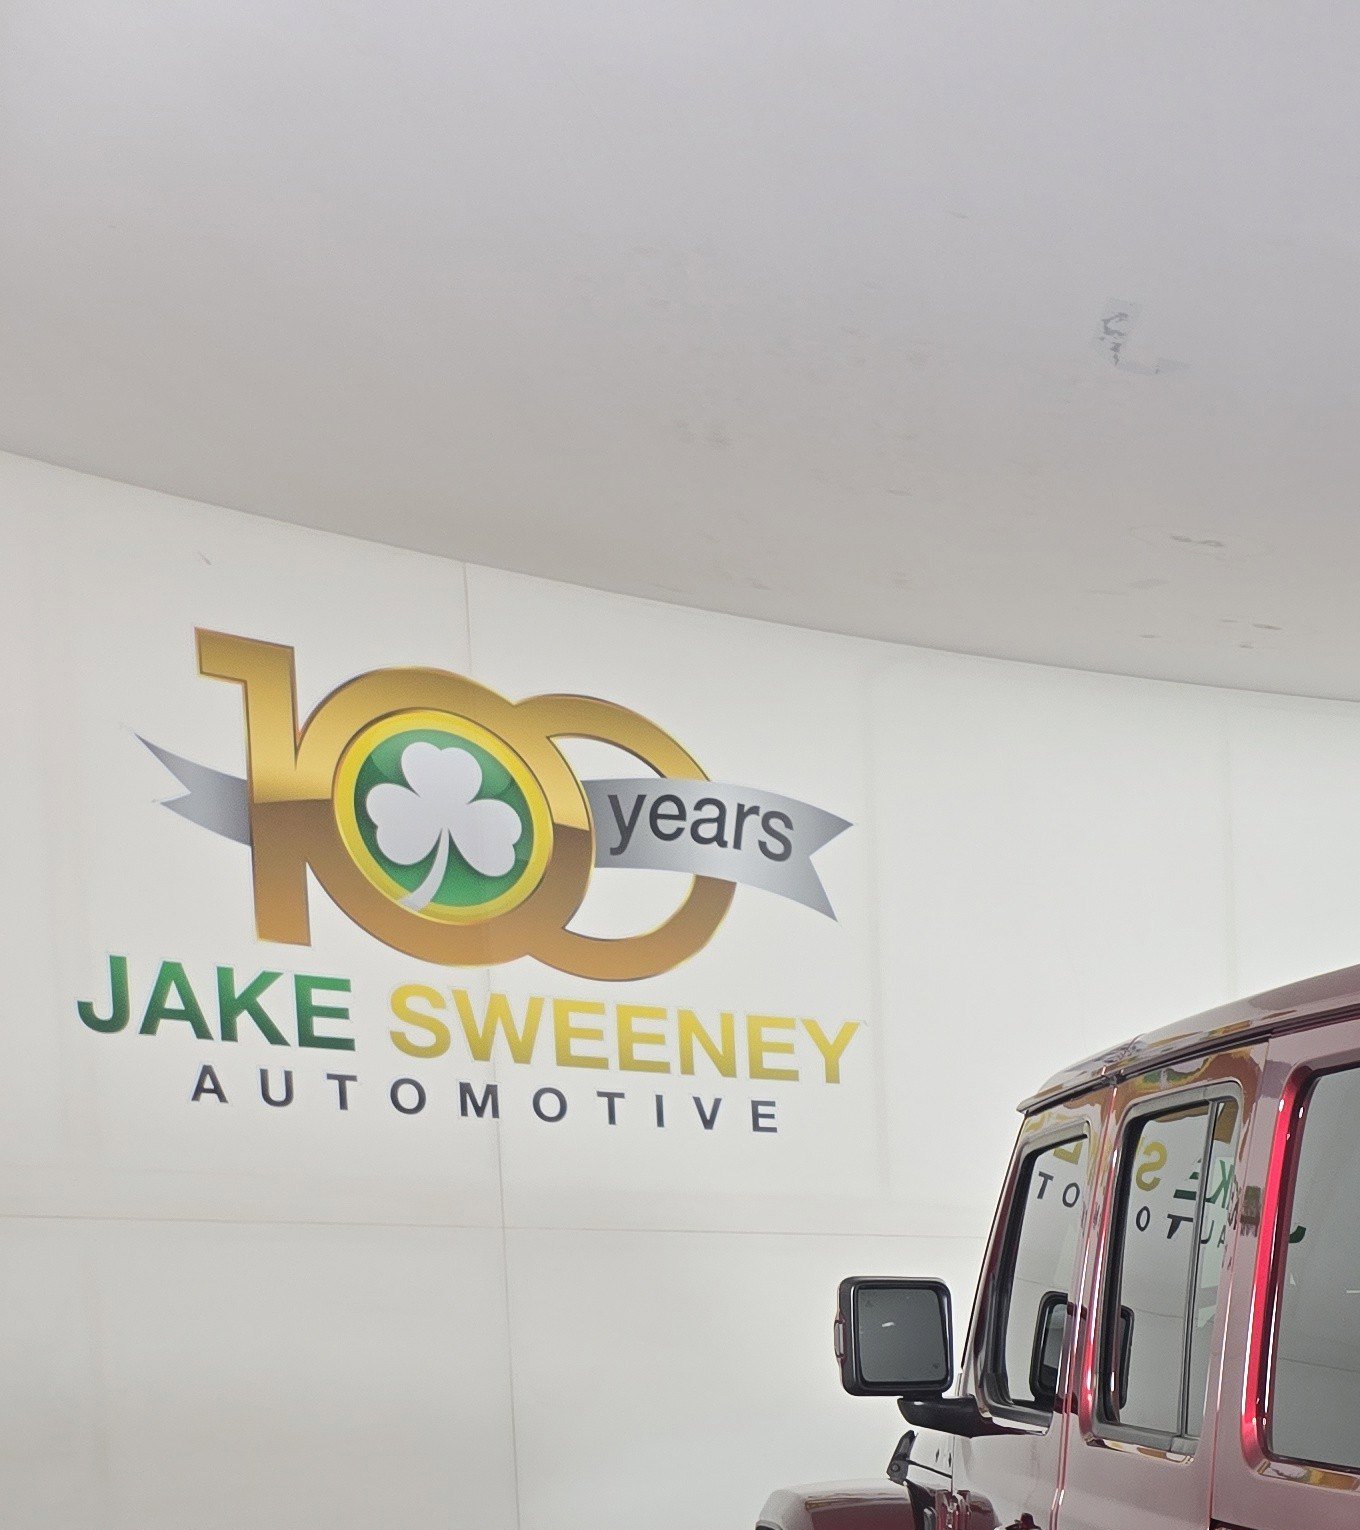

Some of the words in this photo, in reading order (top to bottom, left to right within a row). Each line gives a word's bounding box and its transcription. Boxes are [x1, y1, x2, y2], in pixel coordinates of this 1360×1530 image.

[194, 626, 738, 981] 100
[607, 790, 794, 862] years
[77, 954, 357, 1053] JAKE
[389, 984, 862, 1085] SWEENEY
[191, 1063, 779, 1134] AUTOMOTIVE
